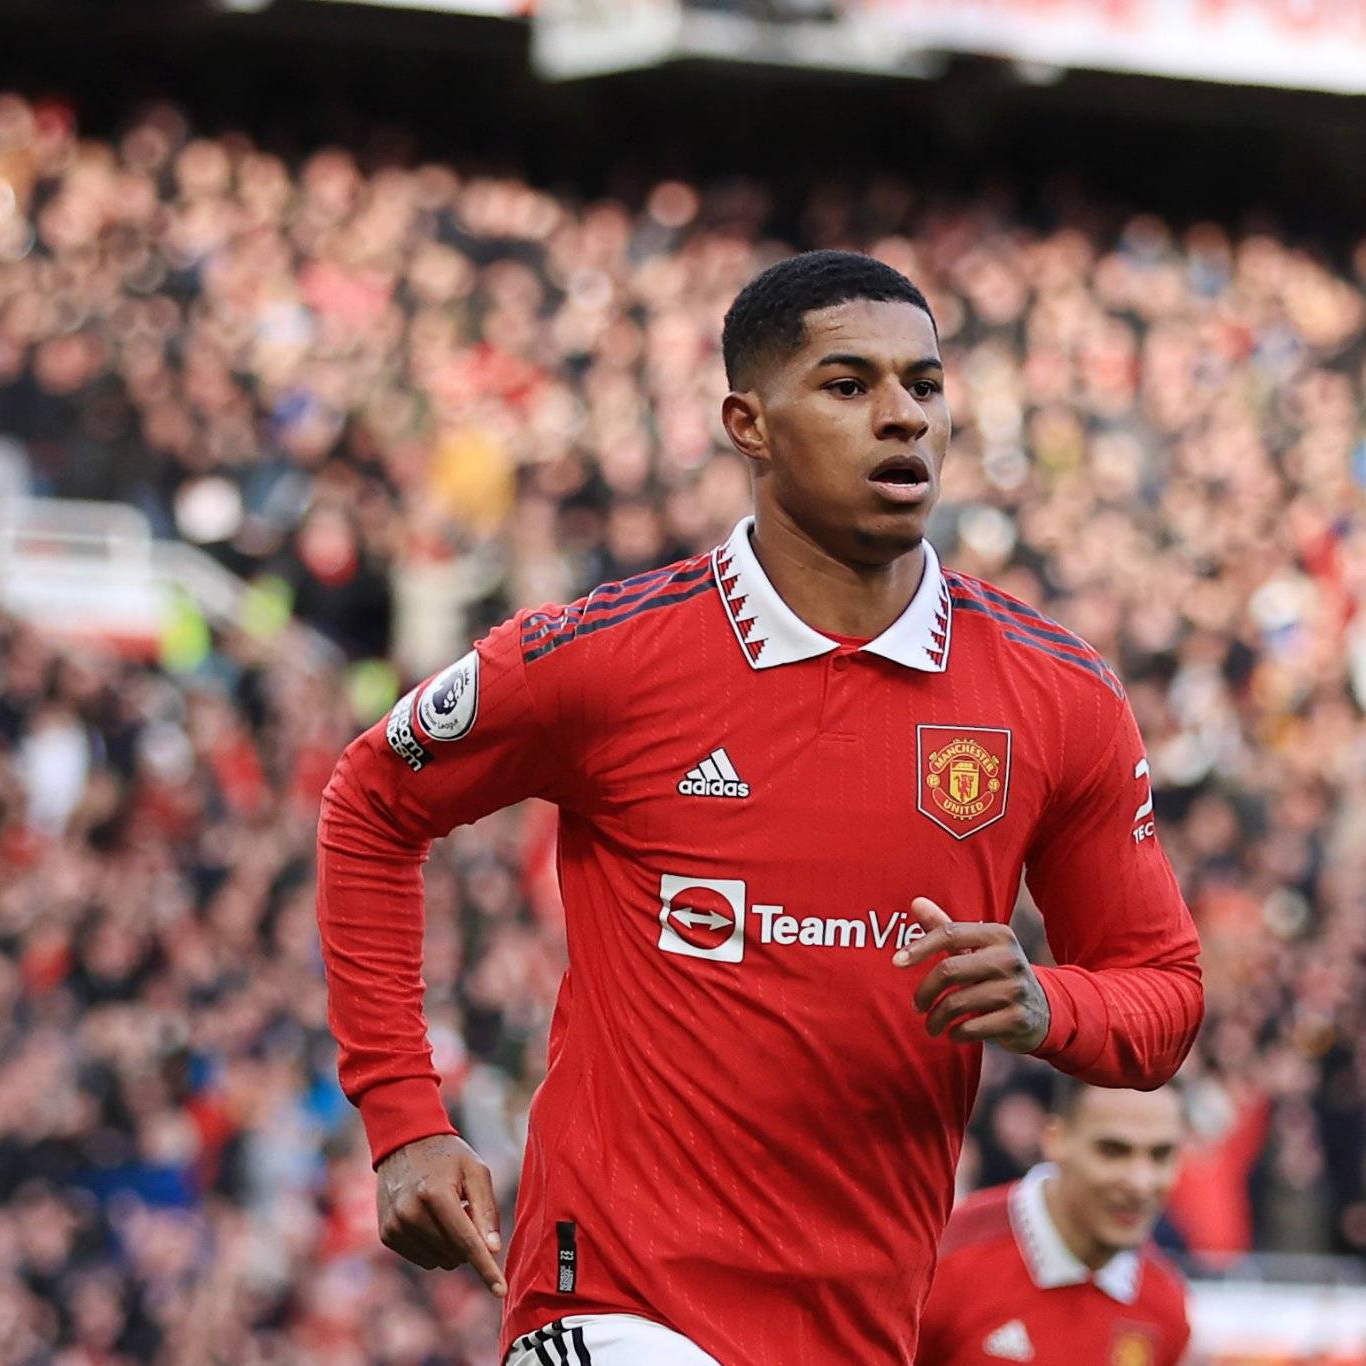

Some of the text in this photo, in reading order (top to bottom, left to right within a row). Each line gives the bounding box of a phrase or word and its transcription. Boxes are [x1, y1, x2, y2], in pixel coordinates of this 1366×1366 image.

[437, 718, 459, 730] League
[934, 744, 995, 772] MANCHESTER
[677, 777, 751, 798] adidas
[942, 798, 984, 815] UNITED
[751, 903, 927, 950] TeamVie
